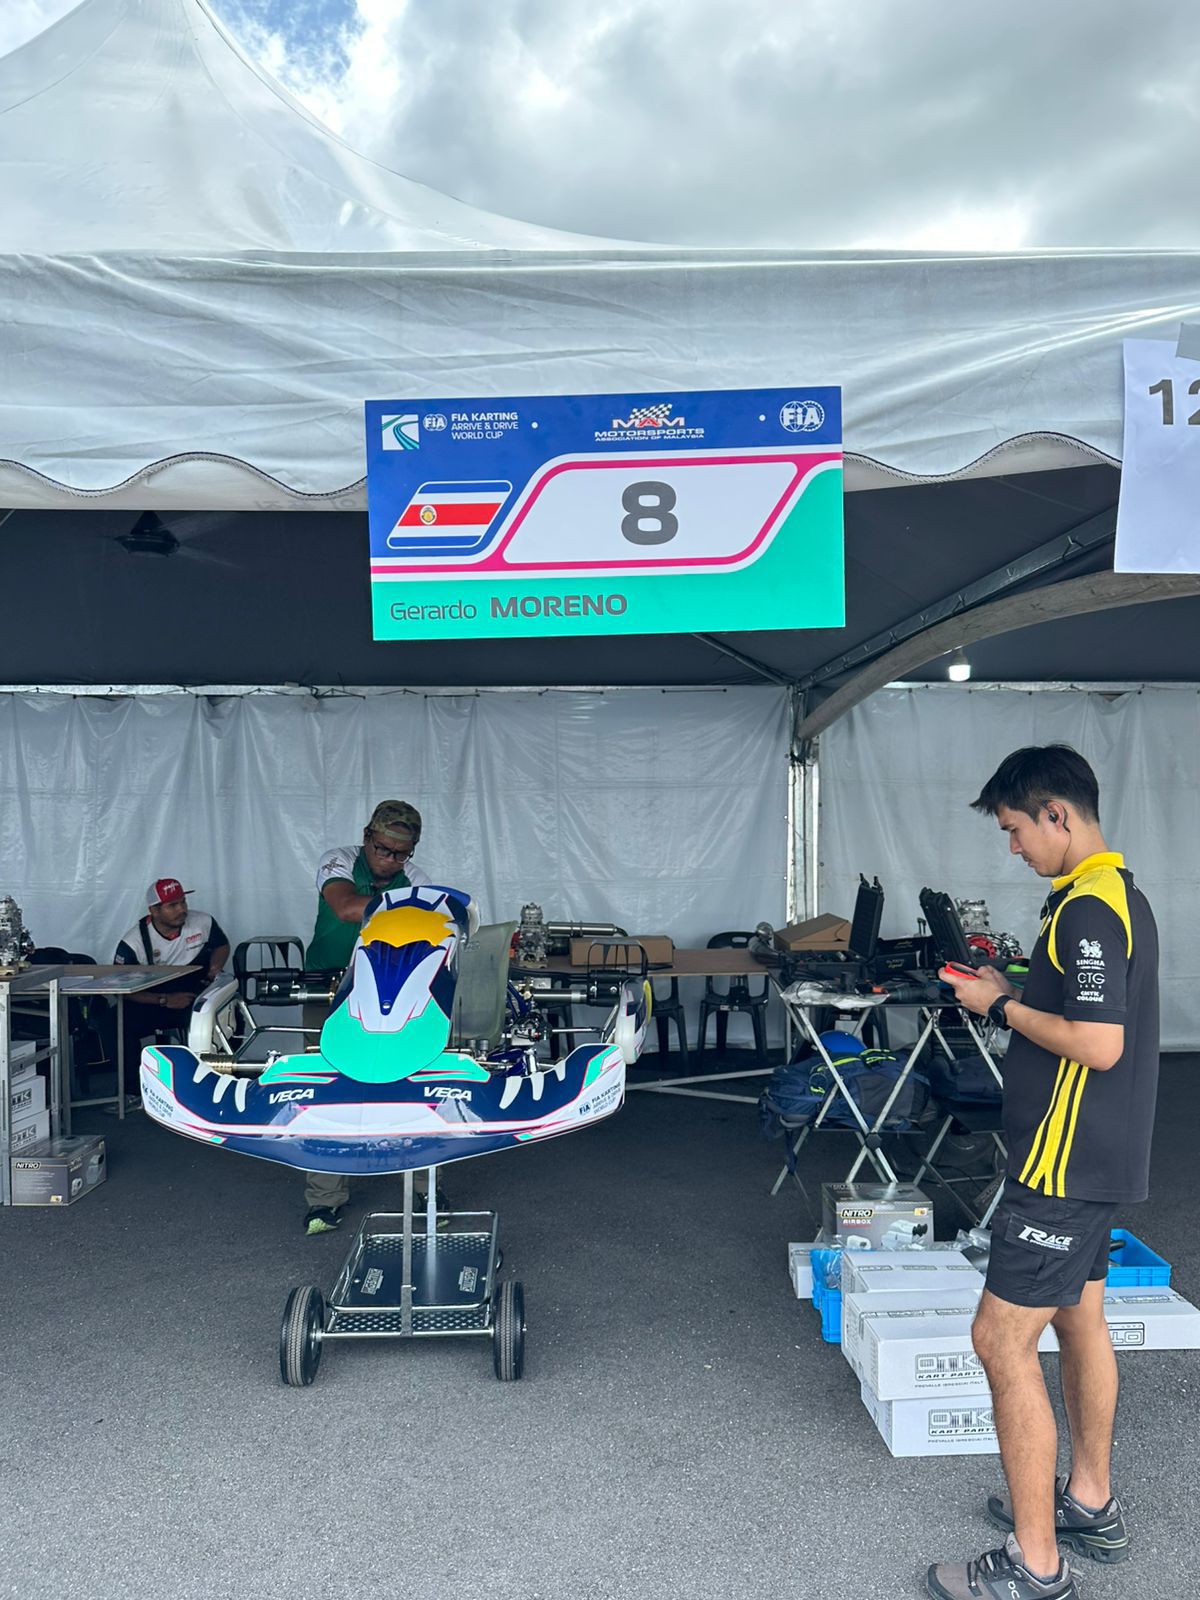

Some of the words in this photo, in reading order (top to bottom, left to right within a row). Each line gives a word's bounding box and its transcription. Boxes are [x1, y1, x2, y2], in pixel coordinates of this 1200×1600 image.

[451, 413, 469, 421] FIA
[471, 412, 519, 421] KARTING
[451, 422, 482, 431] ARRIVE
[484, 422, 491, 430] &
[493, 421, 519, 430] DRIVE
[612, 417, 685, 429] MAM
[451, 431, 484, 440] WORLD
[486, 430, 504, 439] CUP
[594, 428, 705, 438] MOTORSPORTS
[621, 481, 678, 545] 8
[390, 600, 477, 620] Gerardo
[490, 594, 628, 618] MORENO
[1077, 972, 1105, 984] CTG
[269, 1088, 315, 1104] VEGA
[424, 1086, 472, 1101] VEGA
[843, 1209, 871, 1217] NITRO
